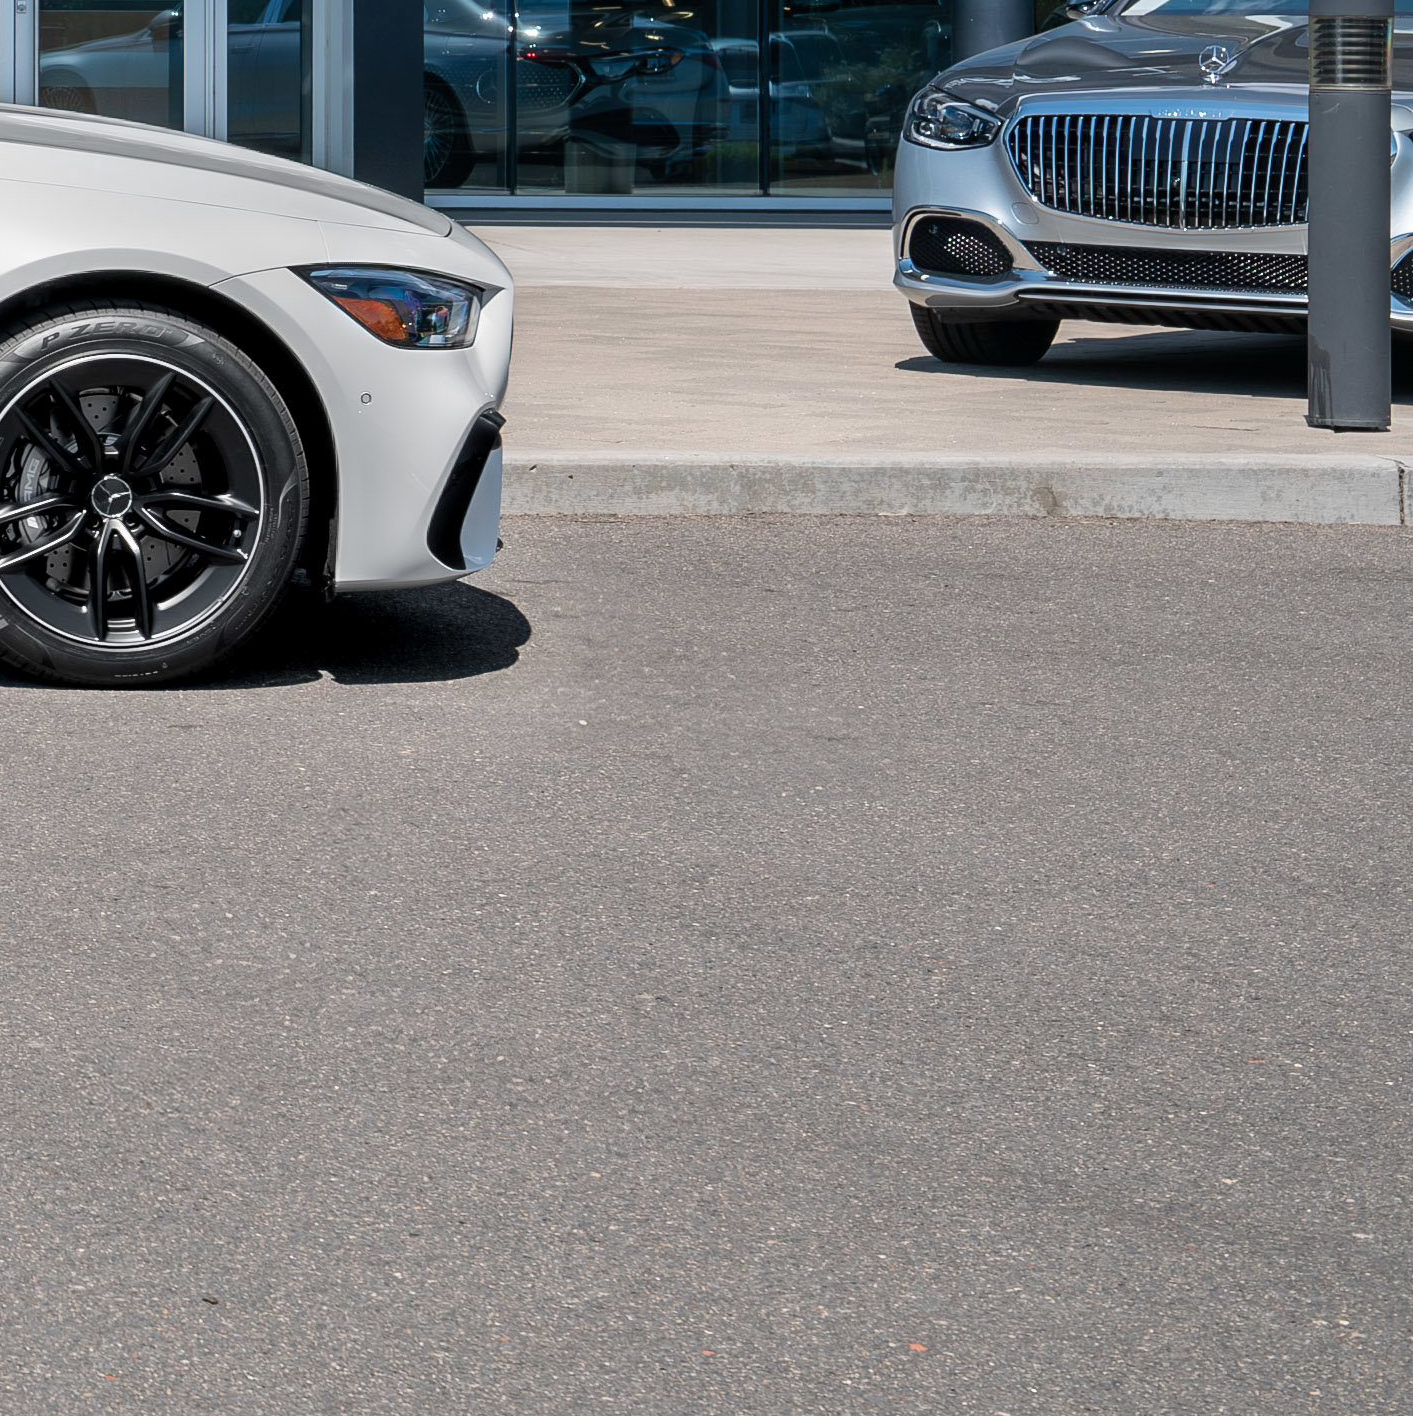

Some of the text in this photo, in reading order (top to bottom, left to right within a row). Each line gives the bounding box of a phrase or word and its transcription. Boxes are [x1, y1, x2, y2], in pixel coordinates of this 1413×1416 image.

[39, 321, 168, 352] P ZERO
[23, 458, 40, 502] AMG
